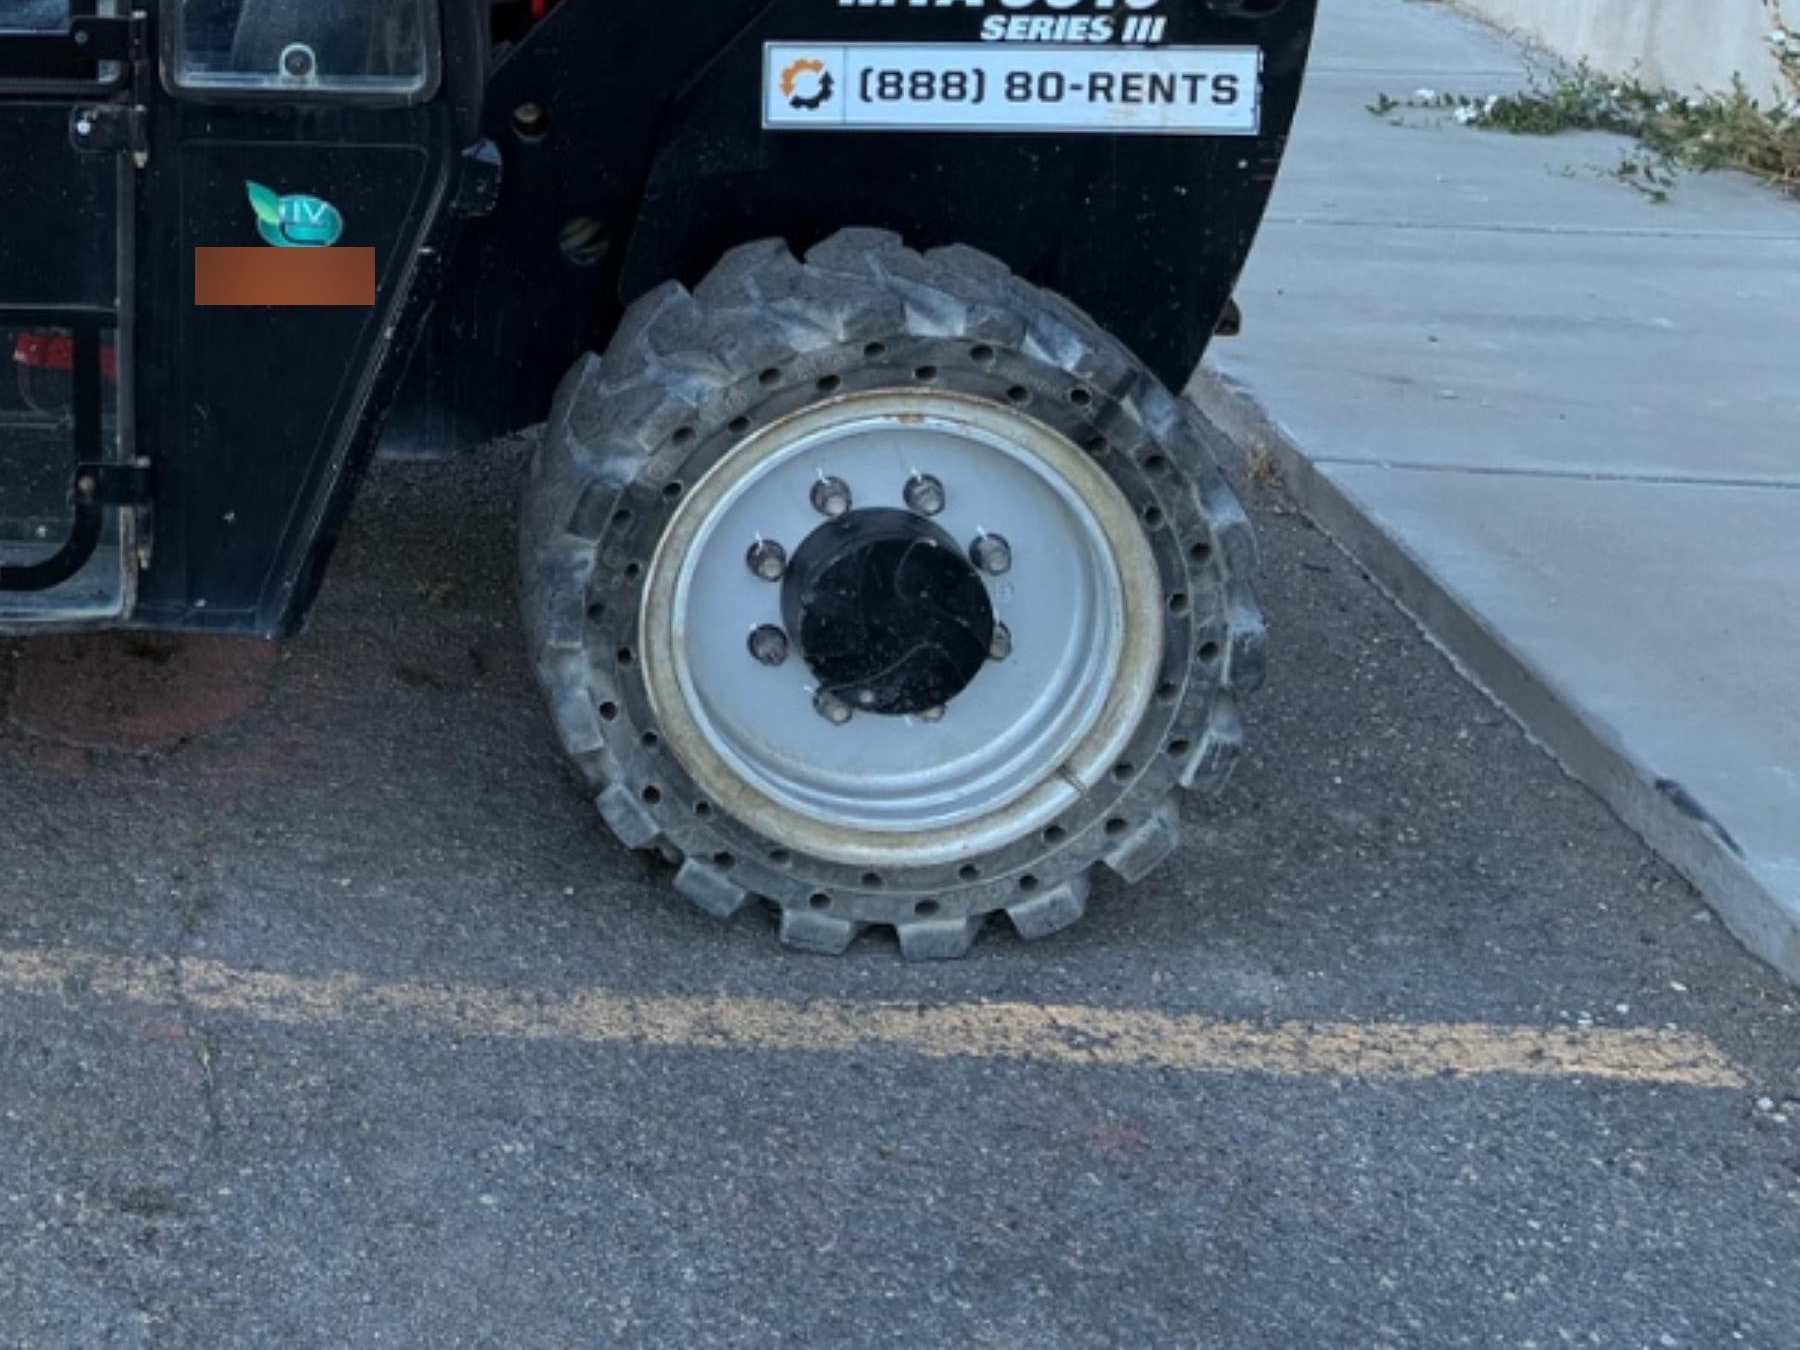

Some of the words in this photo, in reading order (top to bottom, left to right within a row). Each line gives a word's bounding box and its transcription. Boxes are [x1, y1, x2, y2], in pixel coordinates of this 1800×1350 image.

[980, 15, 1115, 42] SERIES
[1121, 16, 1166, 43] III
[860, 68, 986, 103] (888)
[1005, 71, 1240, 105] 80-RENTS
